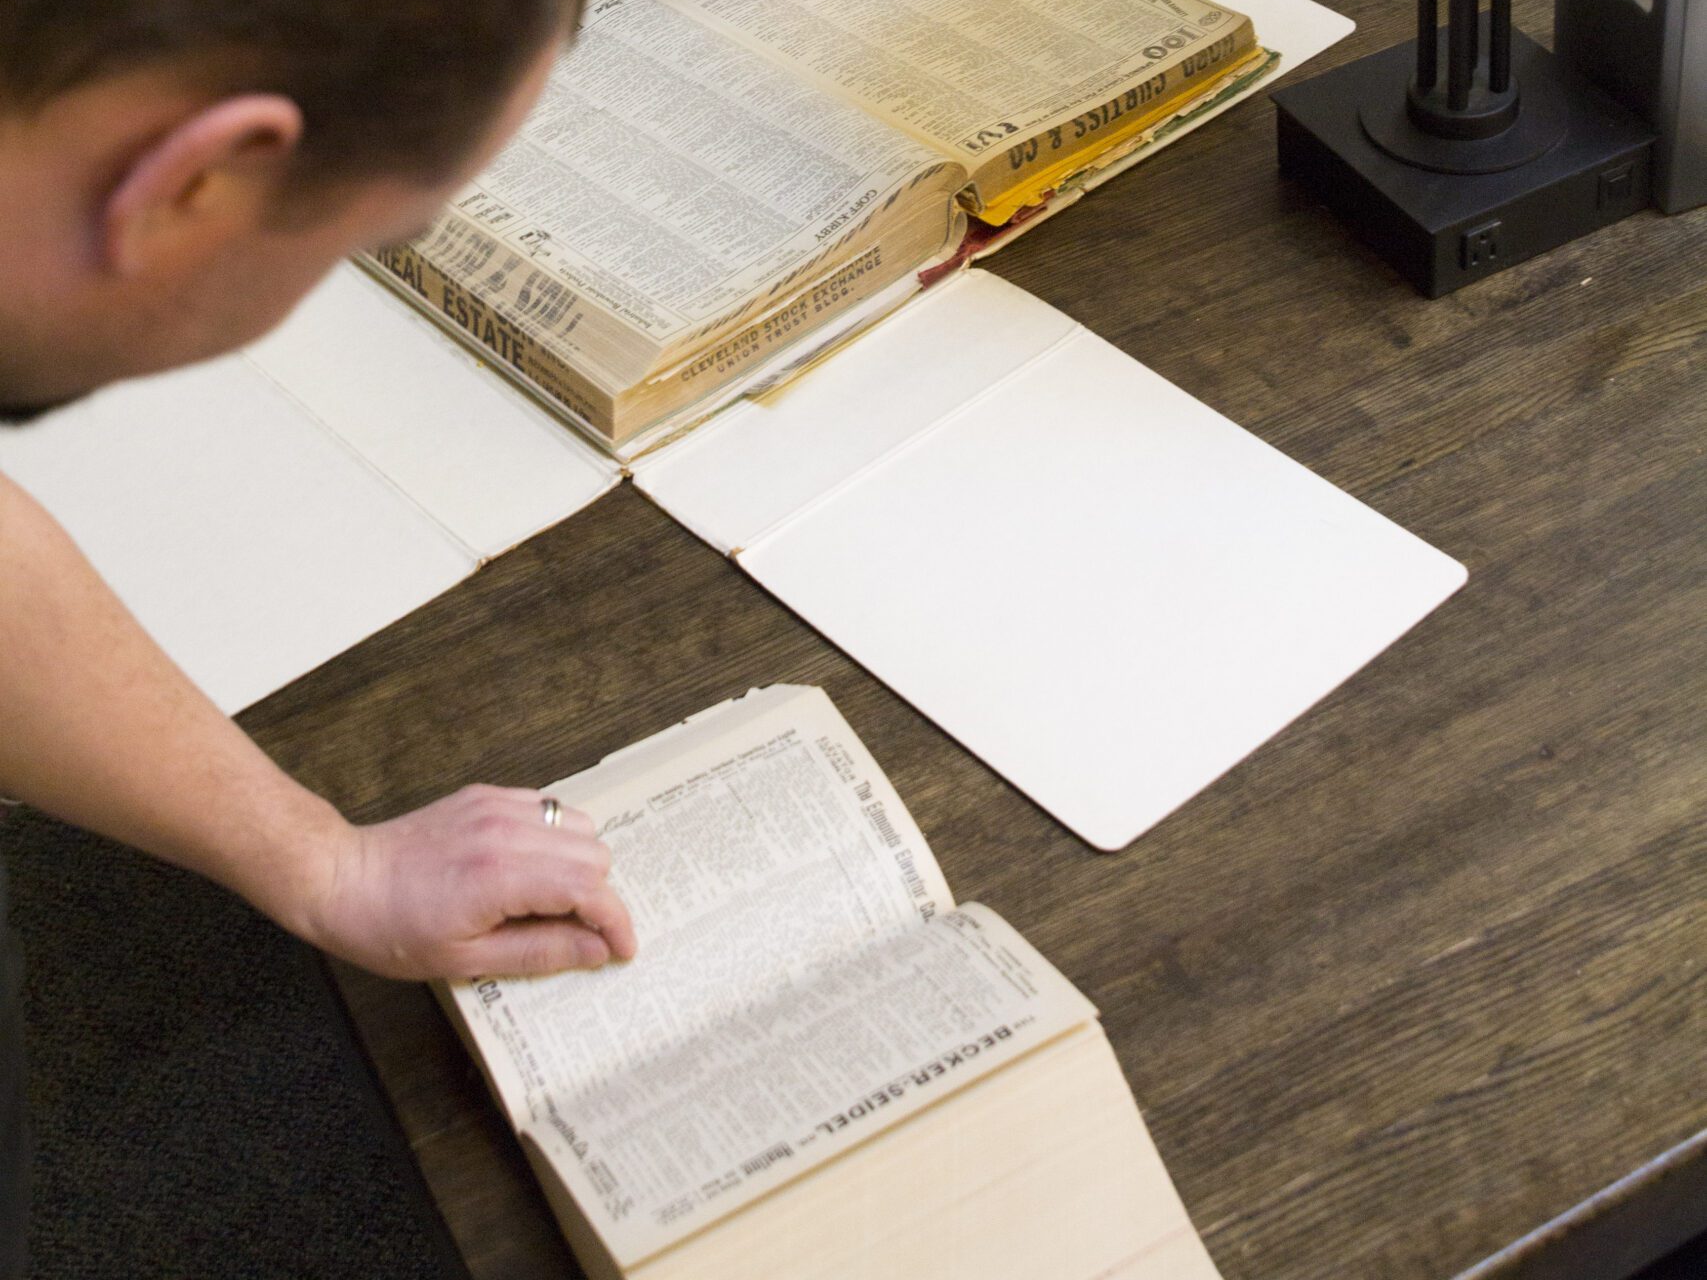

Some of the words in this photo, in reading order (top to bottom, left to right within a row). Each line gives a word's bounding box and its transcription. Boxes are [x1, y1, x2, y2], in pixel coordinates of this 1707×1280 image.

[1047, 127, 1064, 150] &
[1072, 73, 1167, 140] CURTISS
[814, 188, 878, 242] GOFF-KIRBY
[443, 285, 525, 373] ESTATE
[680, 325, 759, 383] CLEVELAND
[763, 299, 808, 336] STOCK
[812, 253, 883, 304] EXCHANGE
[715, 342, 760, 373] UNION
[767, 313, 808, 344] TRUST
[853, 779, 872, 802] The
[866, 800, 903, 850] Edmonds
[894, 851, 928, 899] Elevator
[815, 1023, 1014, 1136] BECKER-SEIDEL
[741, 1141, 795, 1177] Heating
